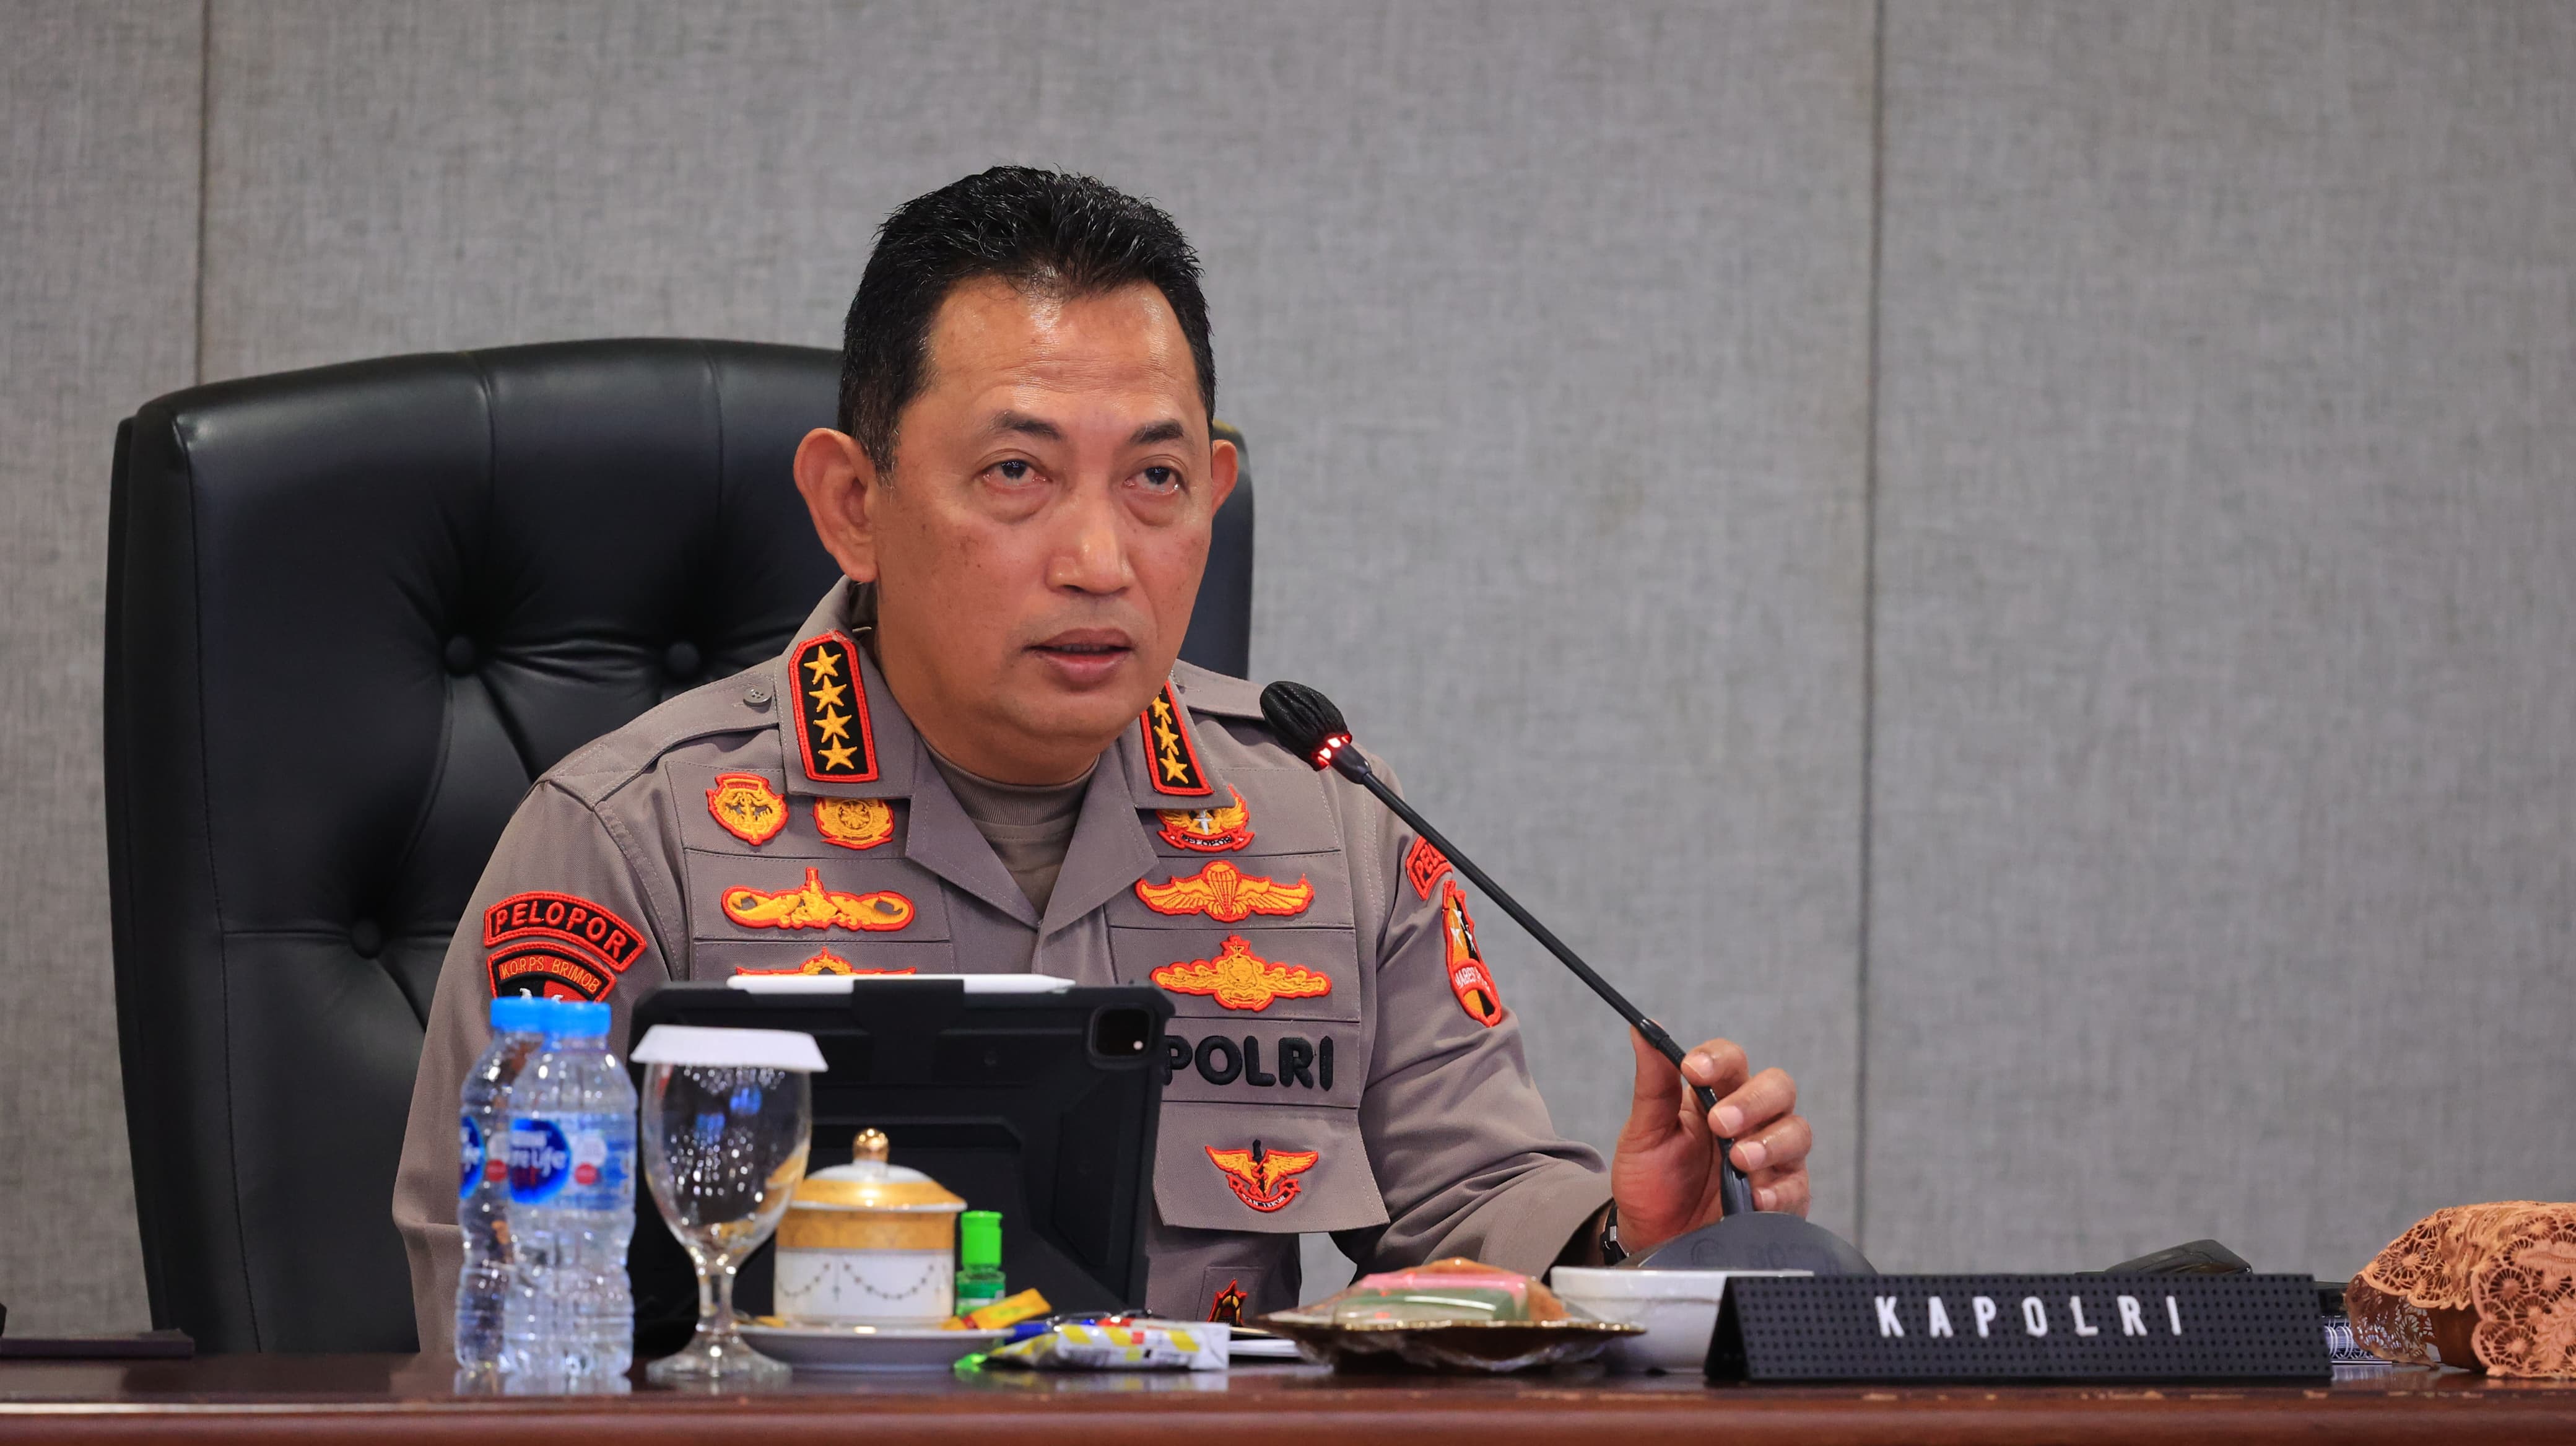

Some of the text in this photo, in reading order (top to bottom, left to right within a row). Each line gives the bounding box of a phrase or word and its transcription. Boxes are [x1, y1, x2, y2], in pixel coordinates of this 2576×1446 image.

[495, 900, 627, 959] PELOPOR
[501, 956, 601, 992] KORPS BRIMOB
[1874, 1295, 2182, 1338] KAPOLRI
